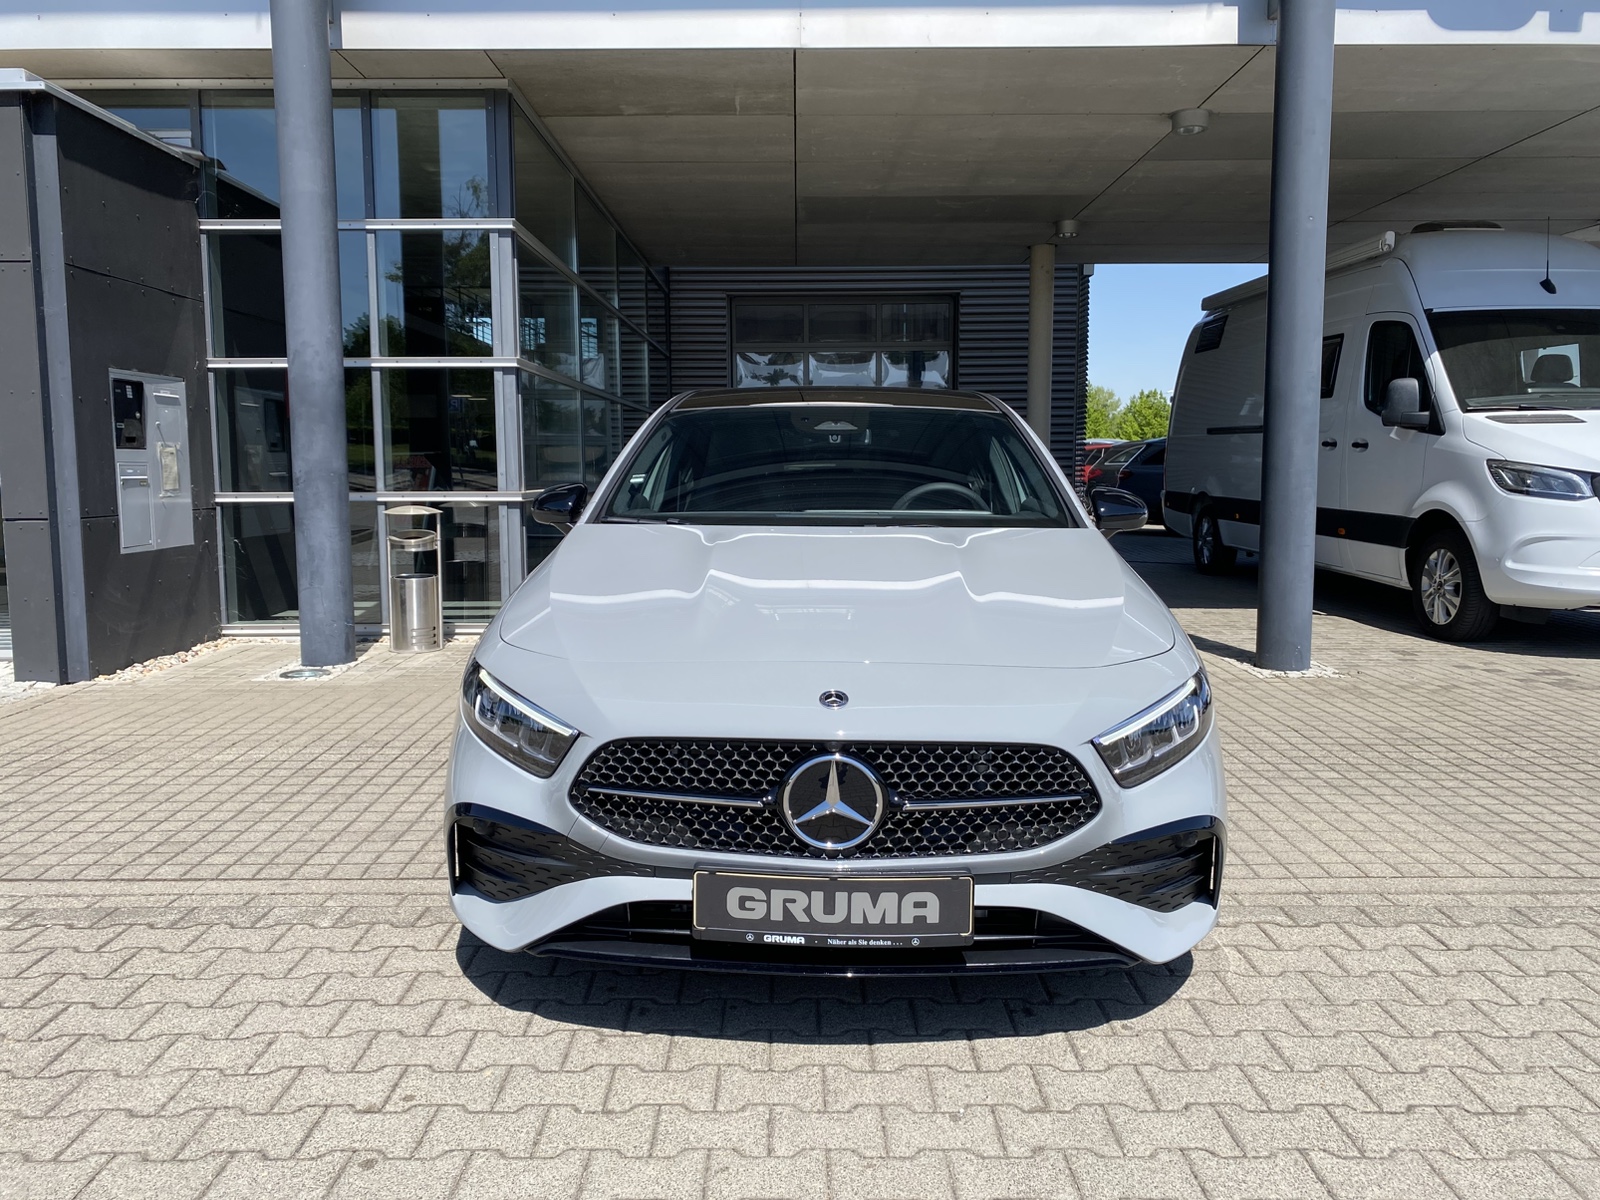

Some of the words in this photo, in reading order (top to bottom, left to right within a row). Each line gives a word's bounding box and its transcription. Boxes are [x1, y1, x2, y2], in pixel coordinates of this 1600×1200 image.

[727, 887, 940, 924] GRUMA
[763, 934, 805, 944] GRUMA
[827, 938, 847, 946] Näher
